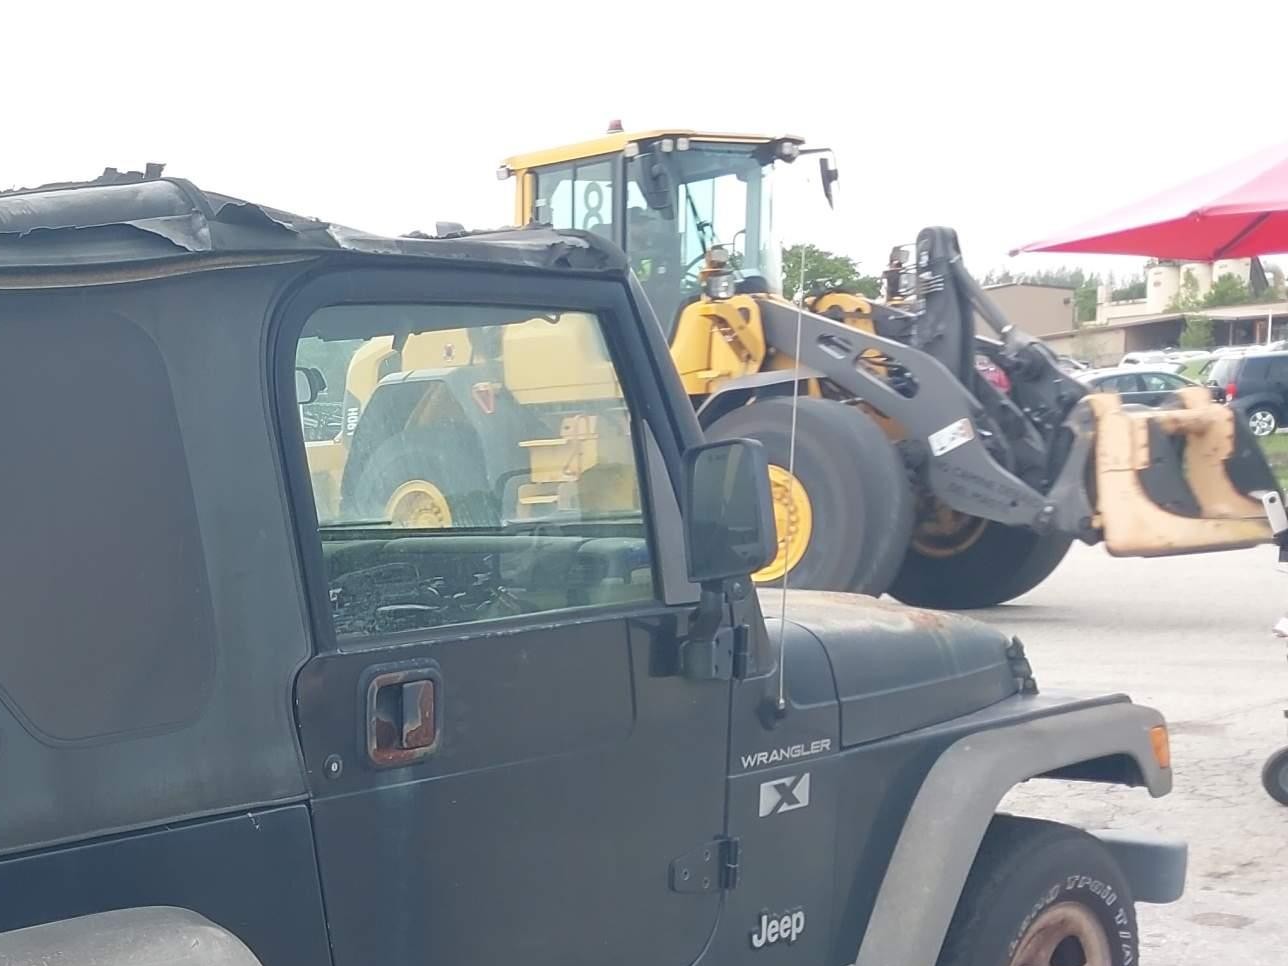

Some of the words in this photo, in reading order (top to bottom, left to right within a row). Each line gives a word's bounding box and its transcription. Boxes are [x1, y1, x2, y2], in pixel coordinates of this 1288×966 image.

[582, 181, 604, 229] 8
[741, 738, 832, 769] WRANGLER
[759, 772, 810, 817] X
[751, 909, 805, 948] Jeep
